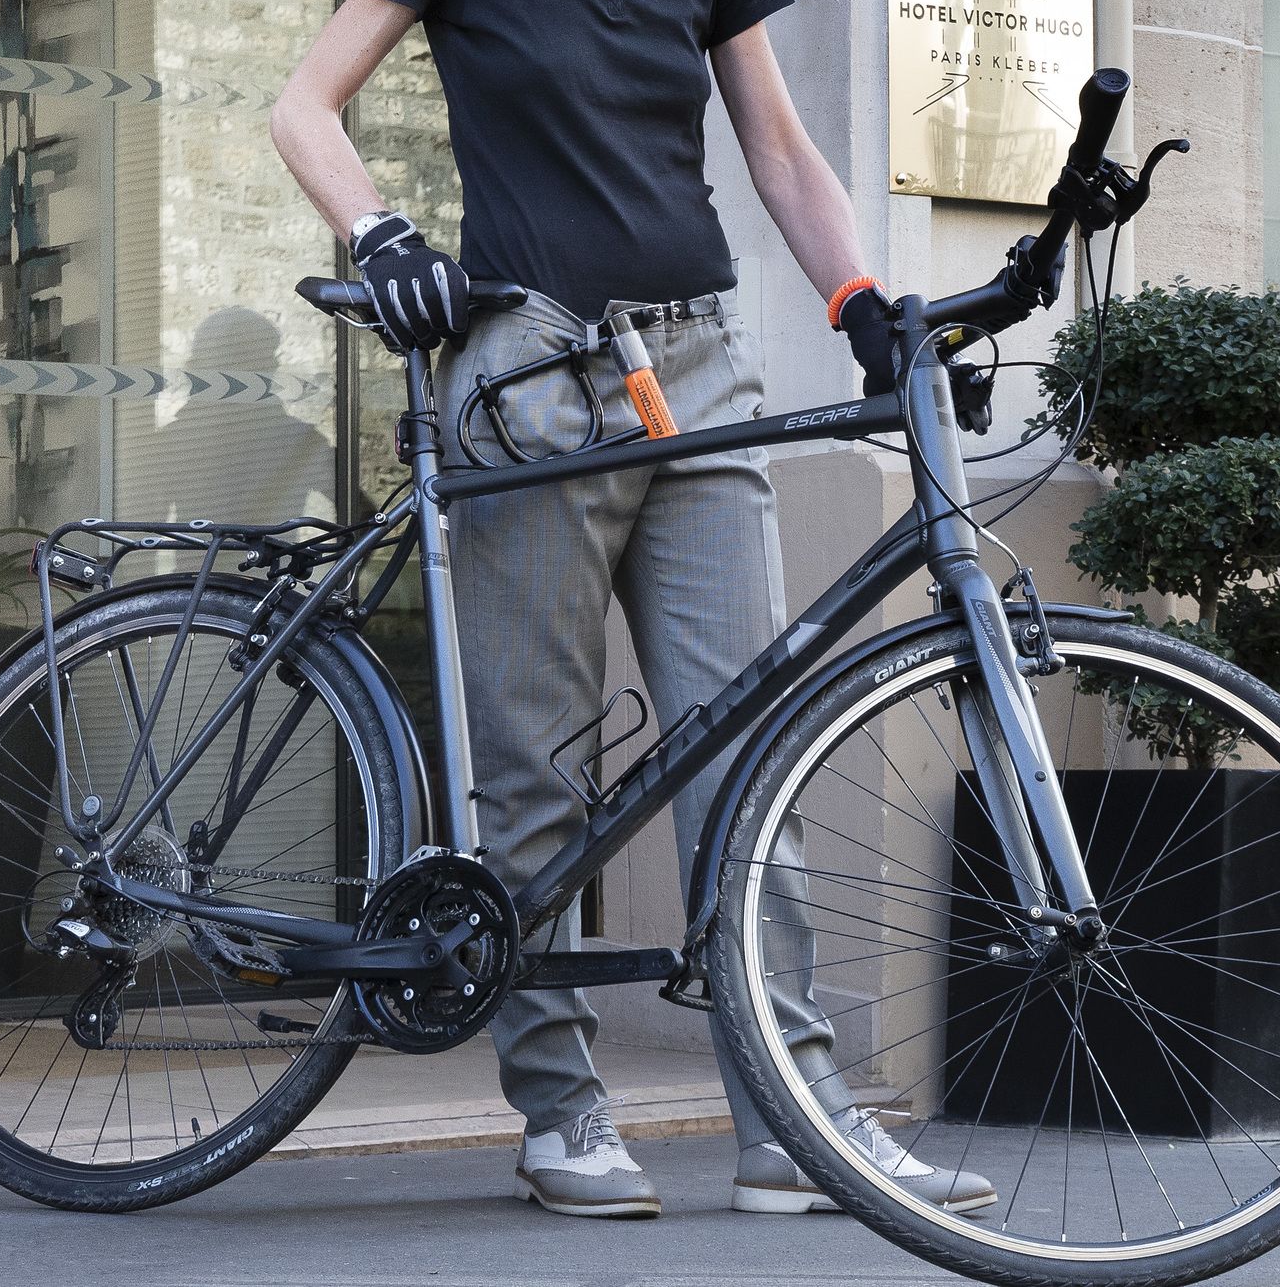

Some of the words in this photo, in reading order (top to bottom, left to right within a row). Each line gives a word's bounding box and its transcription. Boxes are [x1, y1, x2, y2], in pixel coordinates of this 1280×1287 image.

[899, 1, 957, 24] HOTEL
[963, 8, 1028, 32] VICTOR
[1035, 17, 1083, 38] HUGO
[931, 49, 981, 66] PARIS
[993, 55, 1060, 74] KLÉBER
[784, 405, 862, 429] ESCAPE
[975, 601, 997, 637] GIANT
[874, 647, 934, 684] GIANT
[203, 1125, 254, 1165] GIANT
